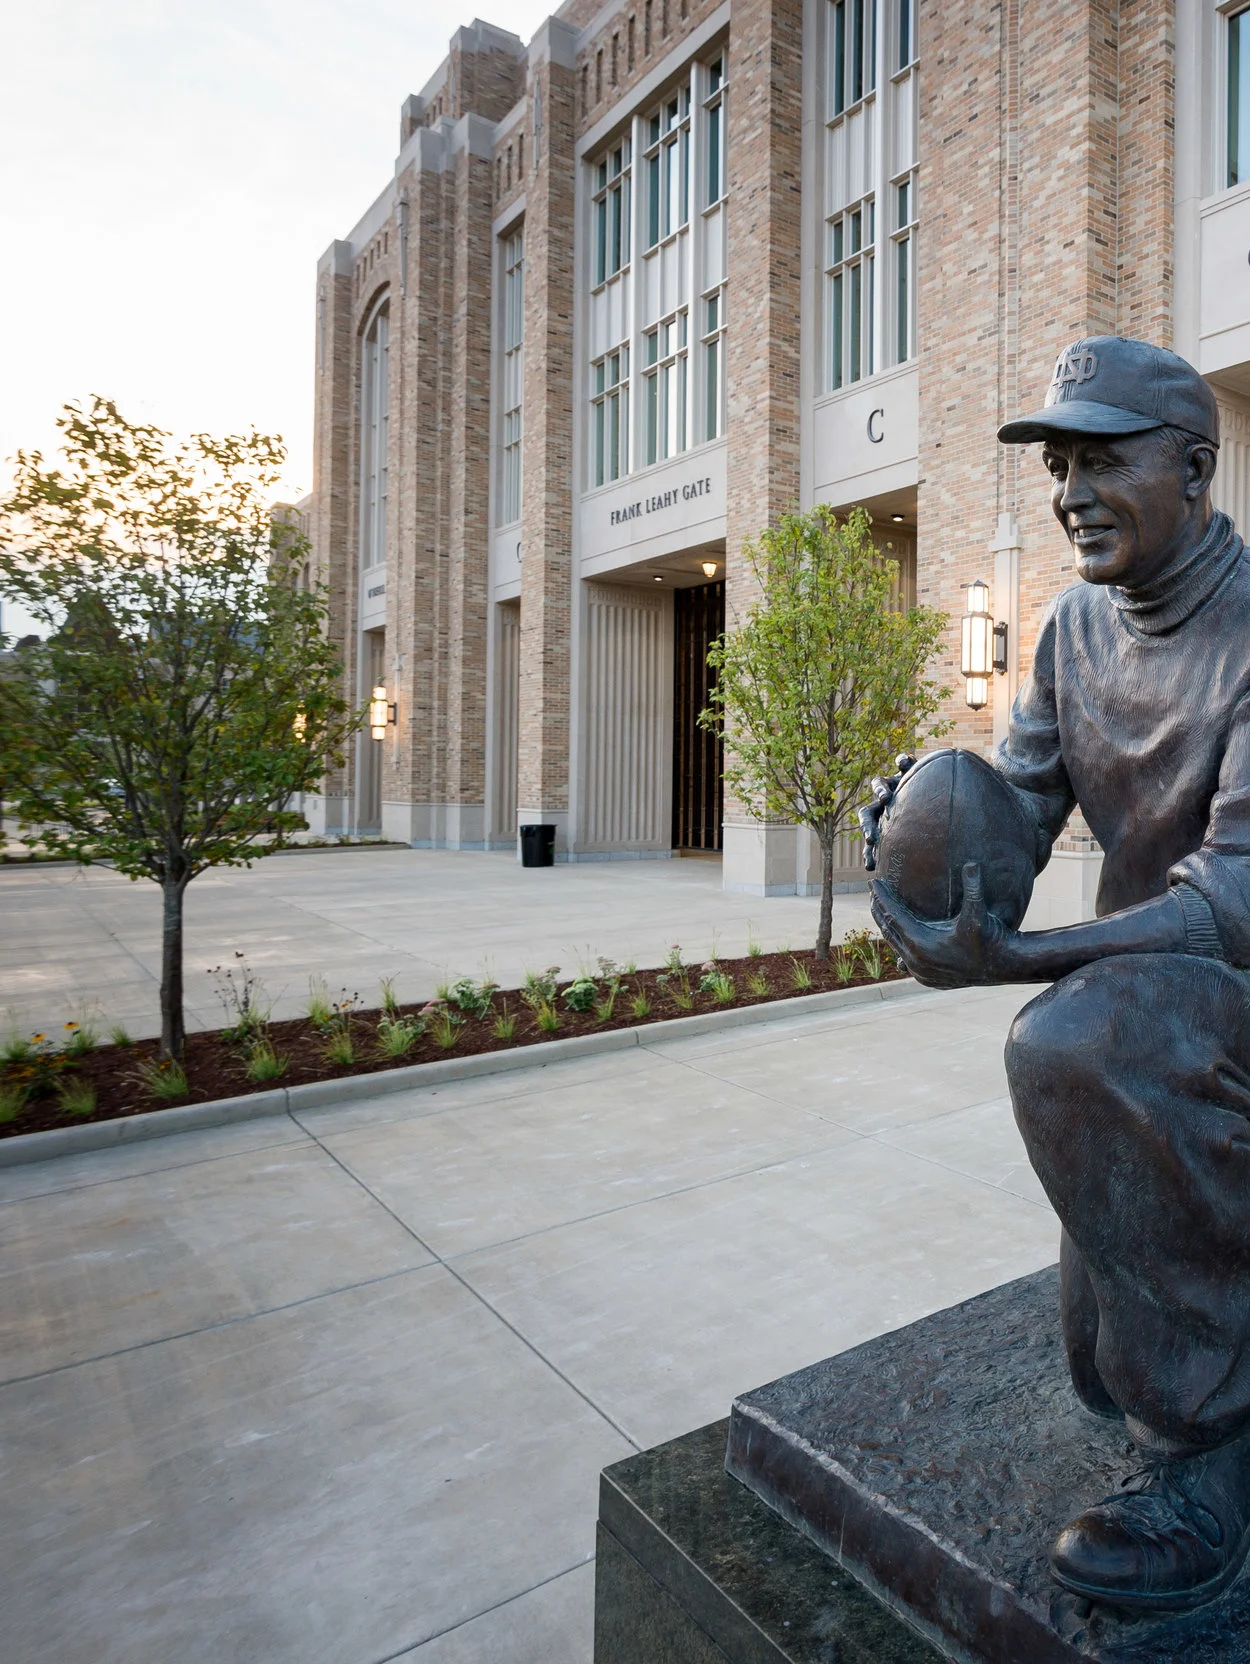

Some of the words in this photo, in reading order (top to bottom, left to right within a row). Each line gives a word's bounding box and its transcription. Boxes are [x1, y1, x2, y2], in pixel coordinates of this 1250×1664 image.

[866, 408, 884, 444] C
[610, 502, 642, 526] FRANK
[645, 488, 679, 514] LEAHY
[682, 477, 711, 501] GATE
